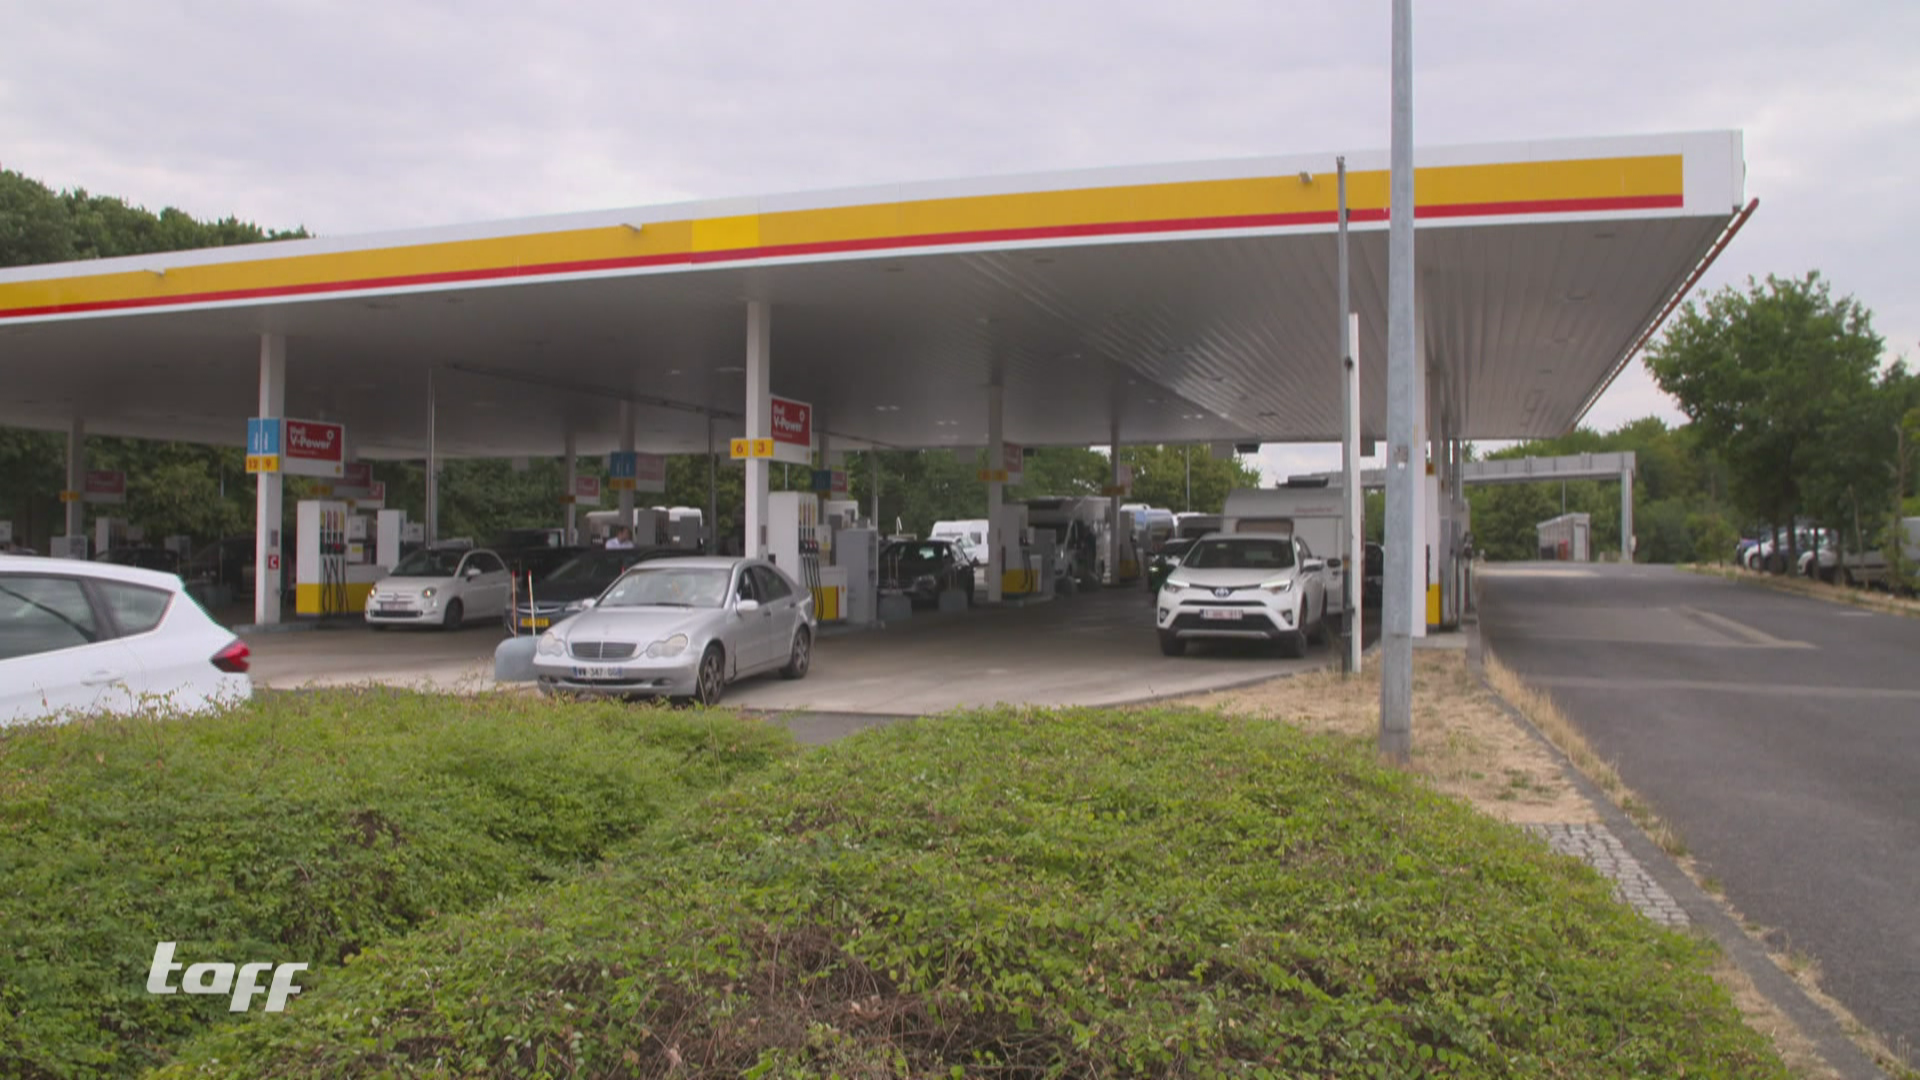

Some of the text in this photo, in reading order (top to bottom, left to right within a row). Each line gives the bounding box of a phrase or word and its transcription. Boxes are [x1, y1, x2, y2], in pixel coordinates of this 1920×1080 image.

[773, 415, 803, 433] V-Power
[290, 434, 332, 450] V-Power
[757, 441, 766, 454] 3
[735, 443, 744, 455] 6
[270, 556, 278, 568] C
